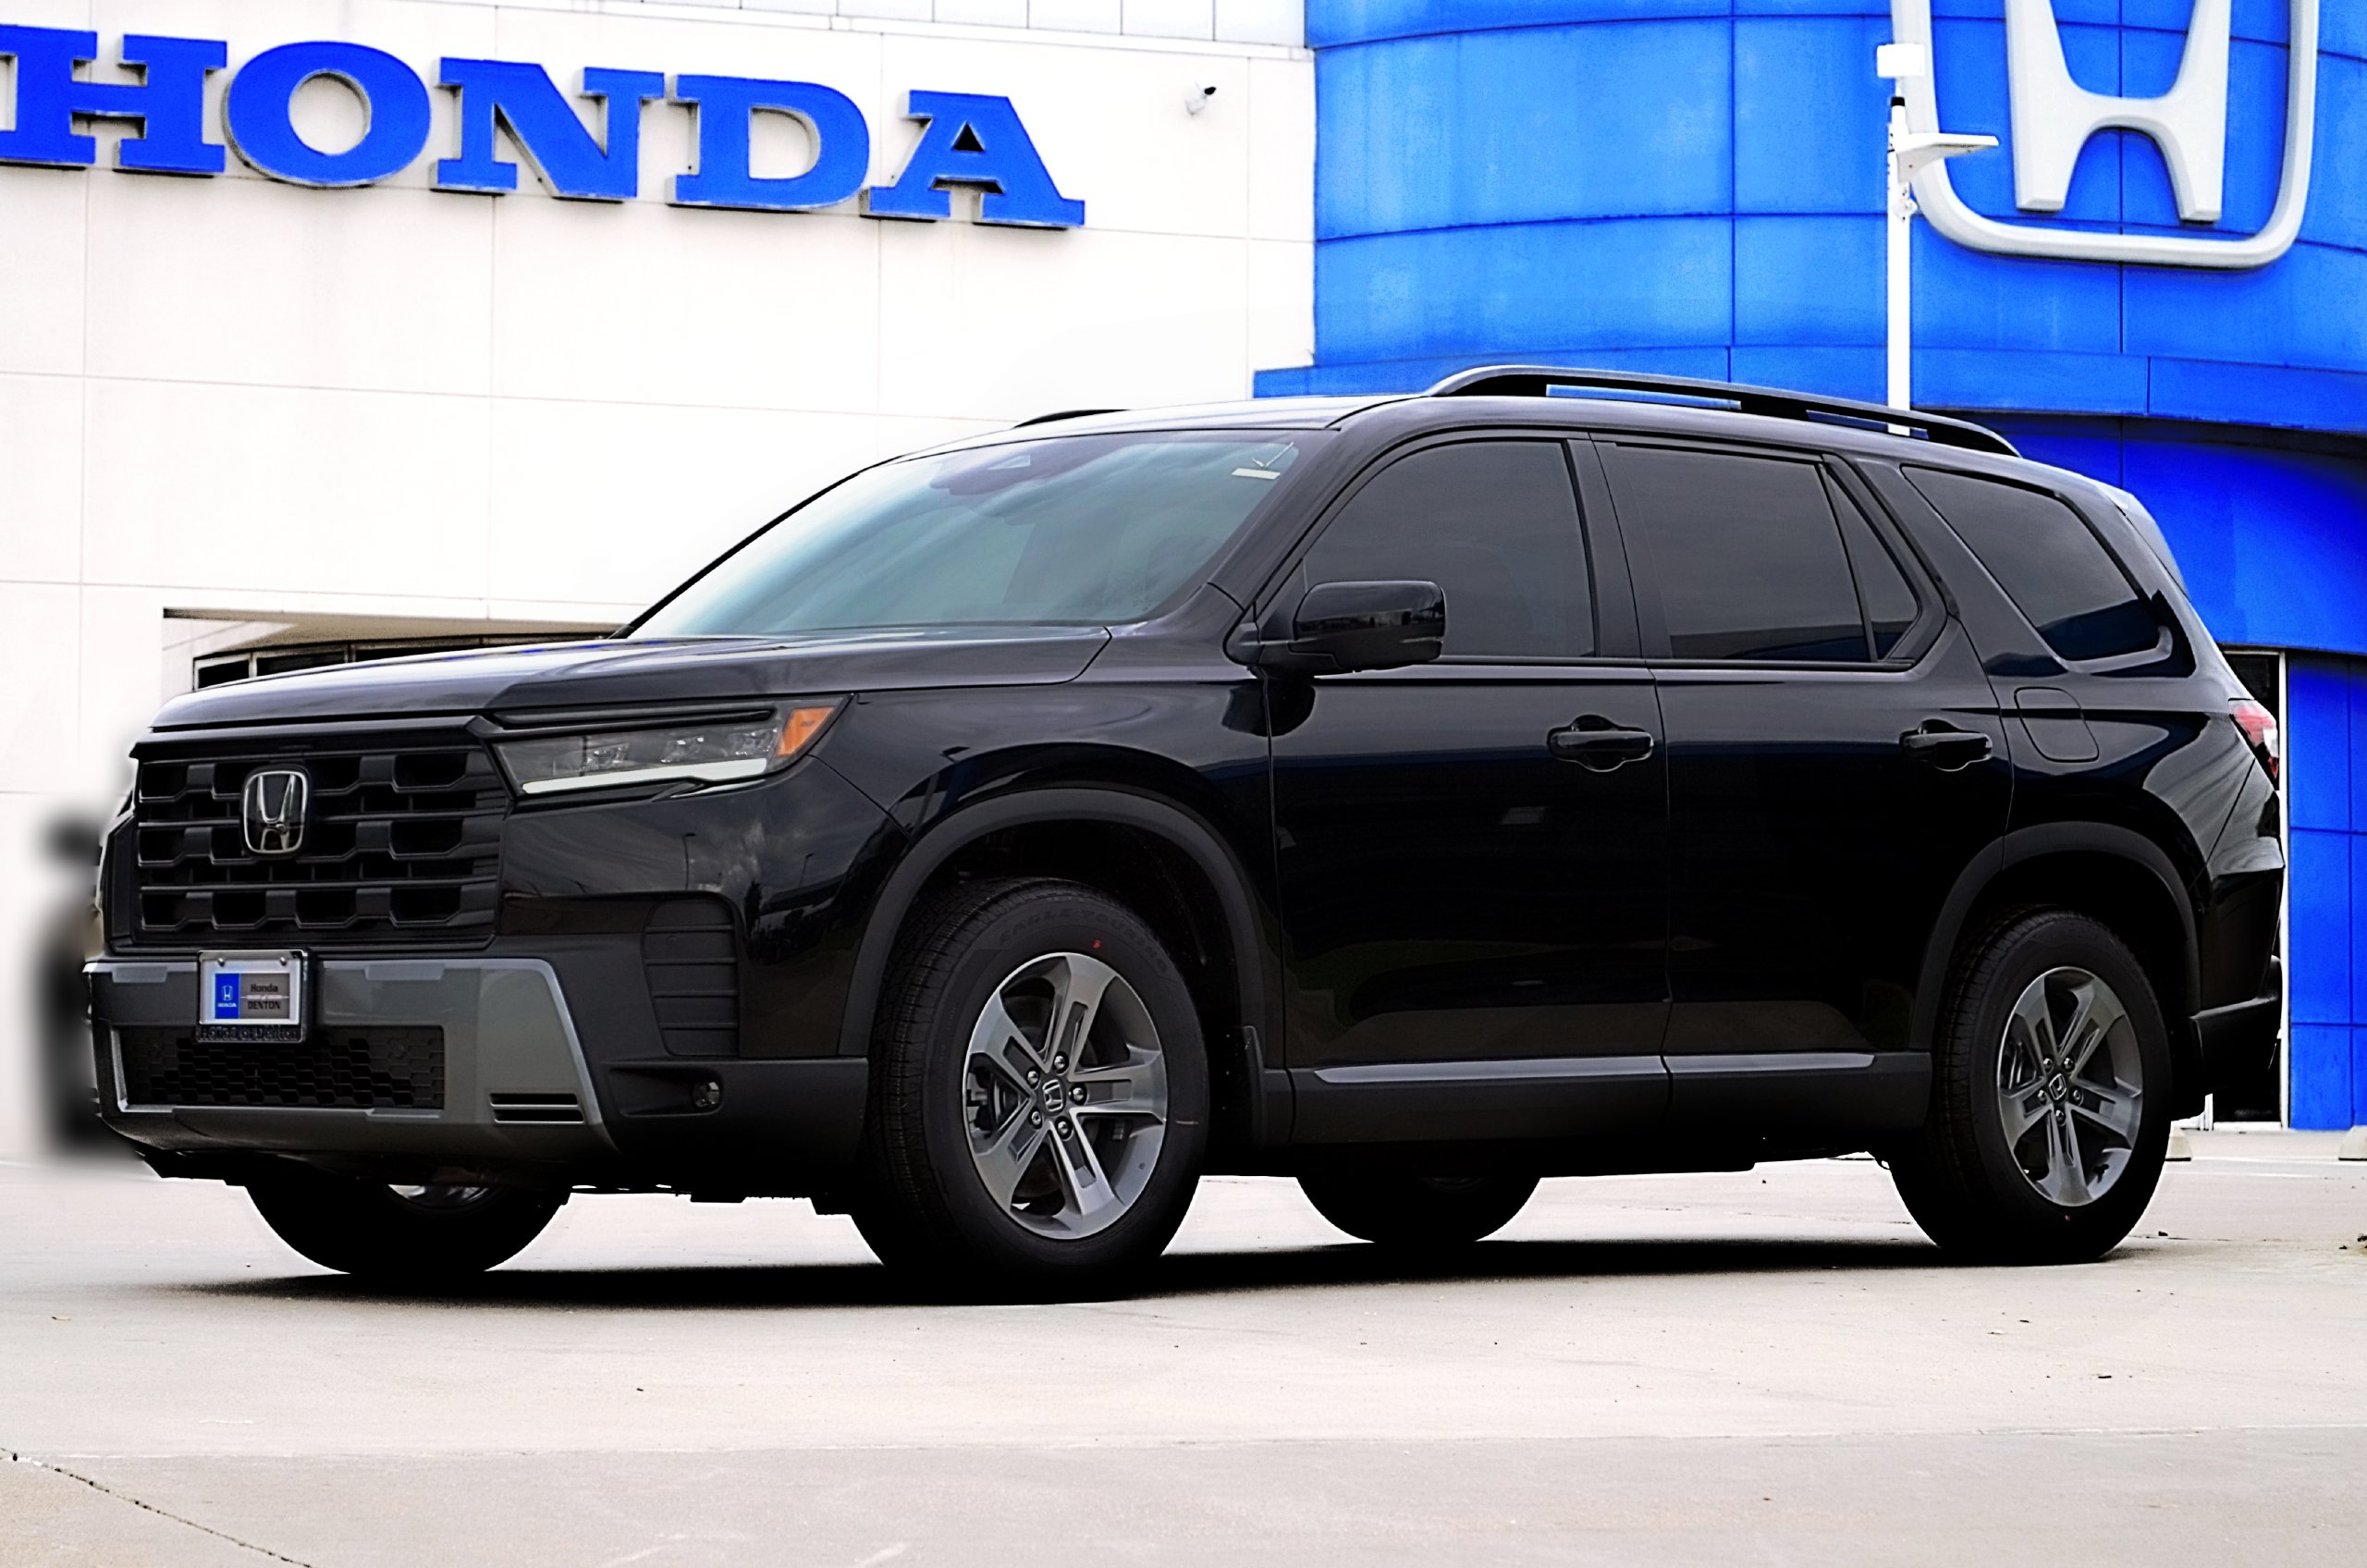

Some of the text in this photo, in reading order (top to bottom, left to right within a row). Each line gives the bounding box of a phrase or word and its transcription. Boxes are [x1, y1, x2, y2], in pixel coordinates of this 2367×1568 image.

[0, 24, 1085, 228] HONDA
[251, 984, 278, 992] Honda
[248, 1001, 280, 1010] DENTON
